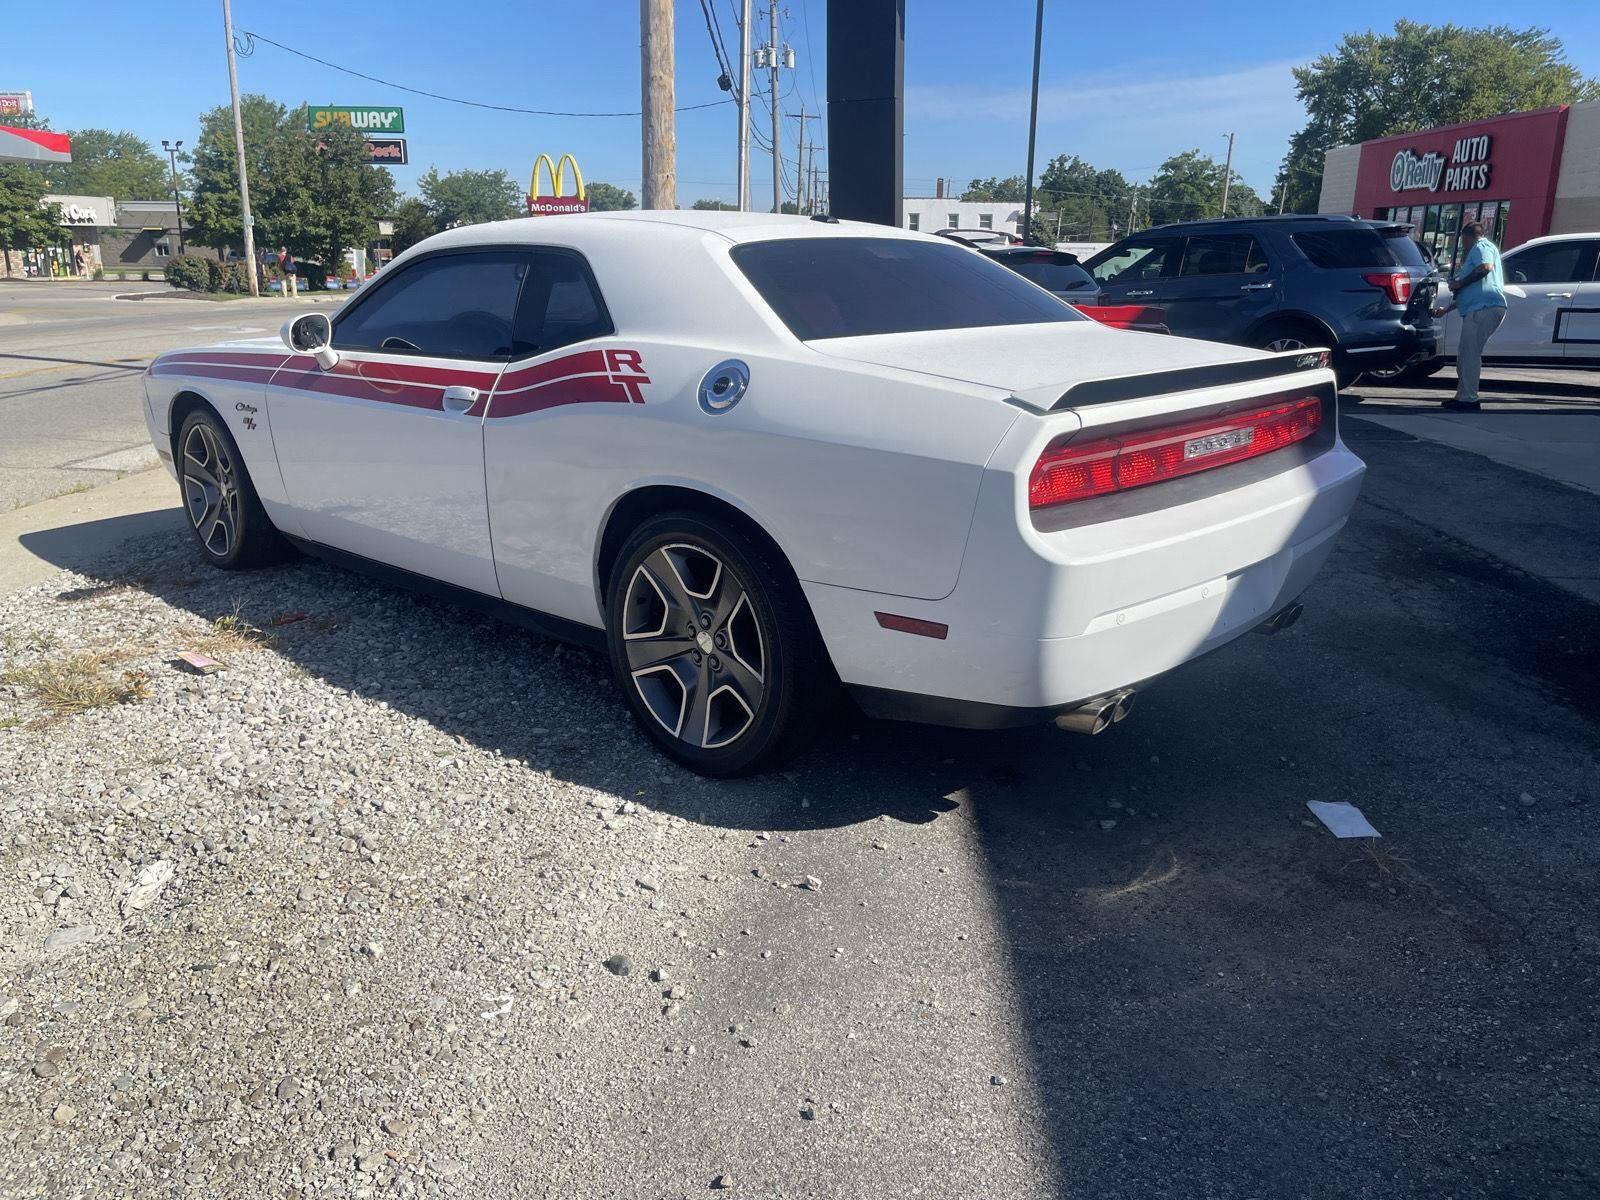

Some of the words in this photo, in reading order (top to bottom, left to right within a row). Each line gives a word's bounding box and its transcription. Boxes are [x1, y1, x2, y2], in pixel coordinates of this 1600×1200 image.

[313, 111, 398, 129] SUBWAY
[1452, 135, 1489, 164] AUTO
[1390, 150, 1446, 192] O'Reilly
[1444, 164, 1489, 191] PARTS
[531, 203, 586, 212] McDonald's
